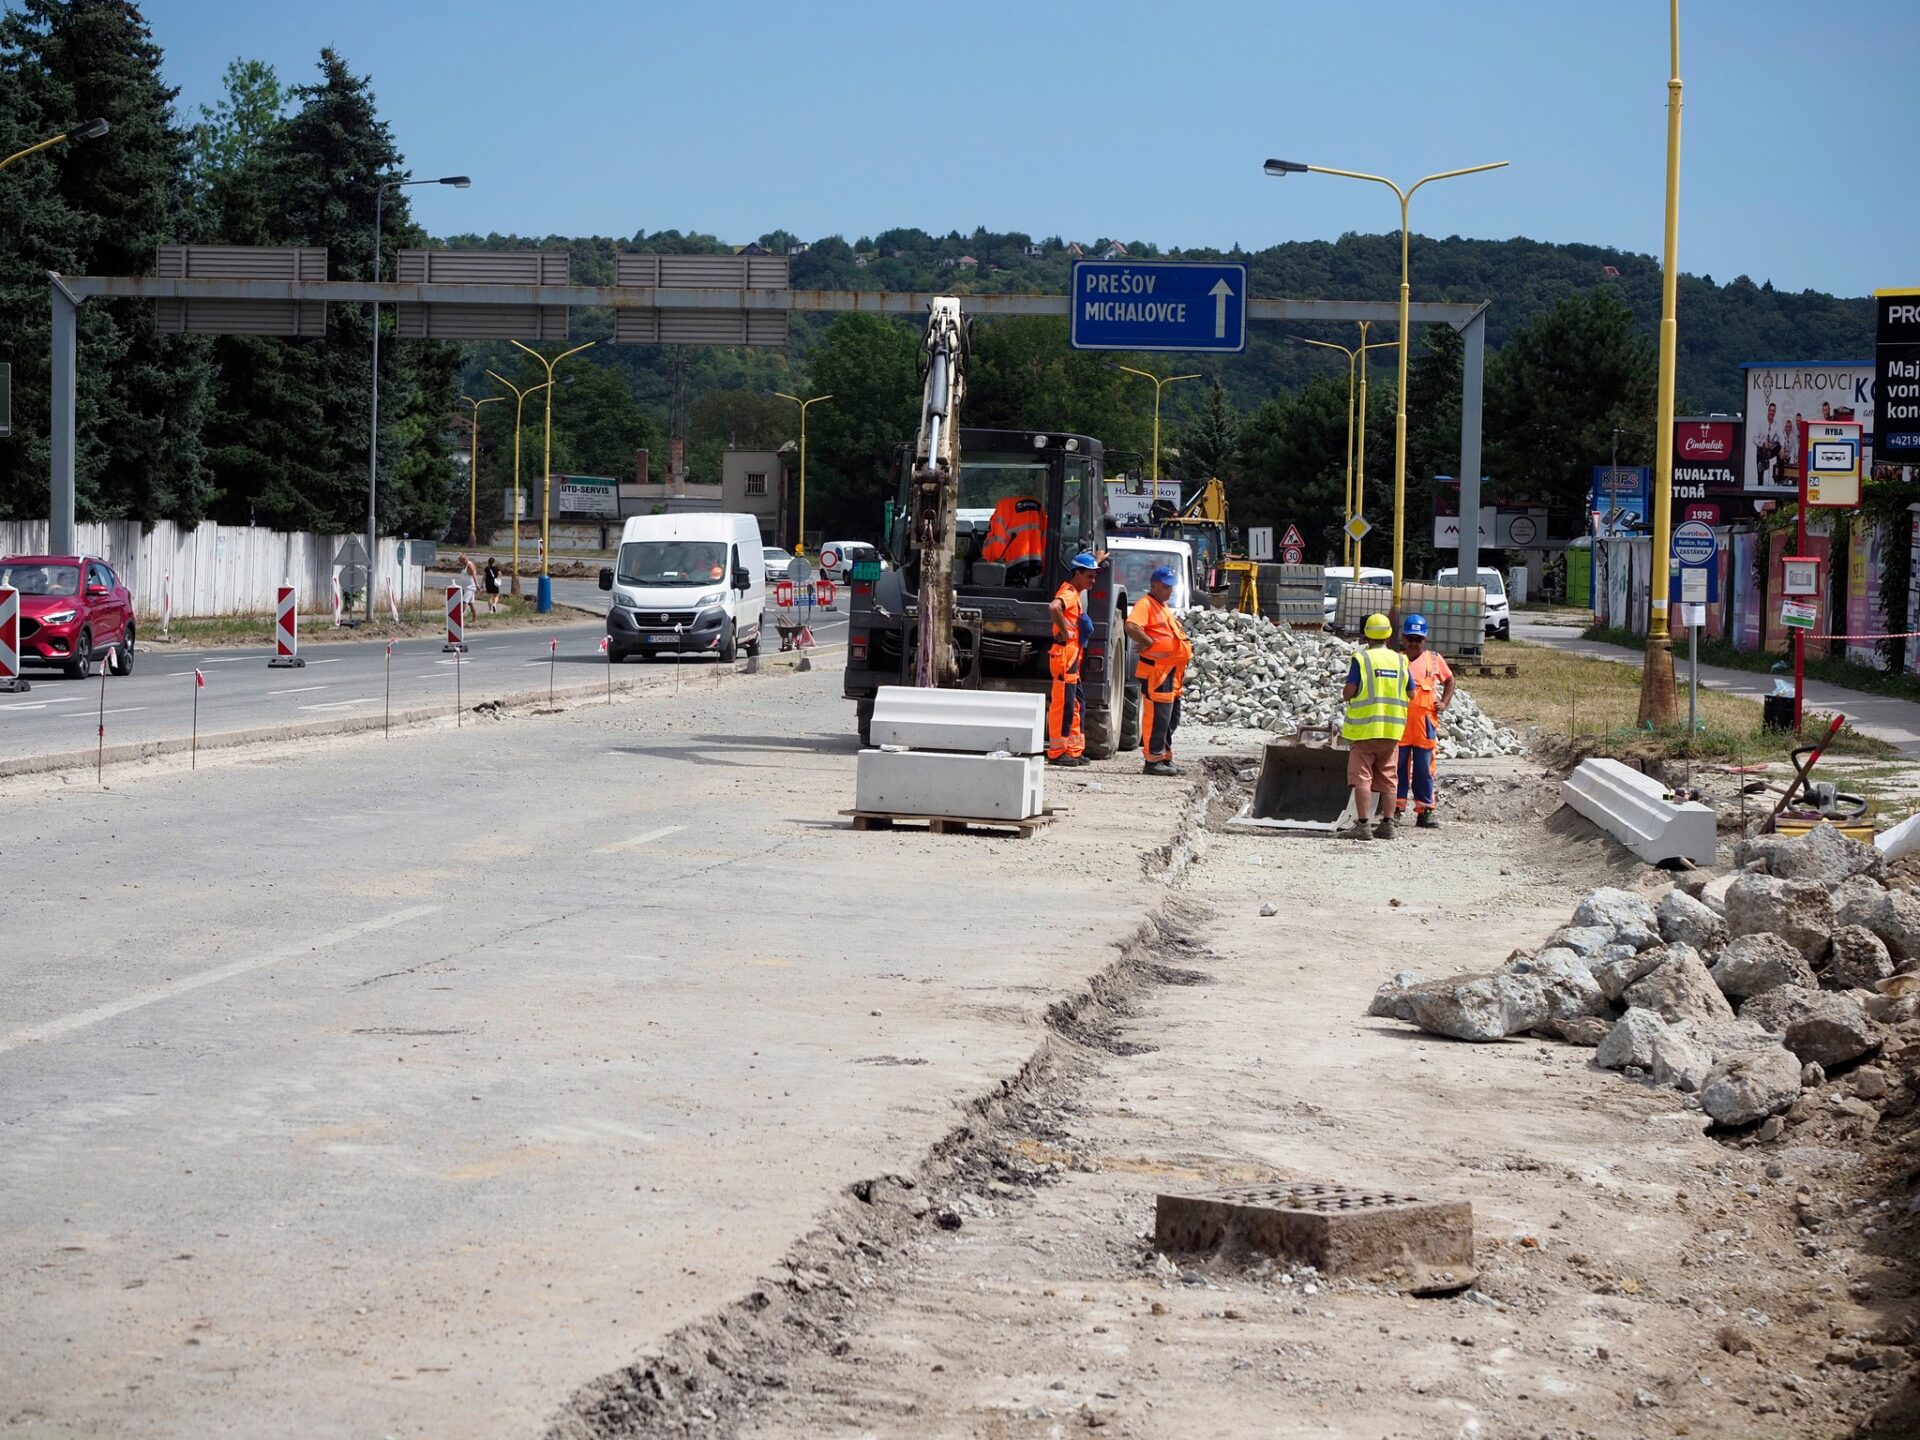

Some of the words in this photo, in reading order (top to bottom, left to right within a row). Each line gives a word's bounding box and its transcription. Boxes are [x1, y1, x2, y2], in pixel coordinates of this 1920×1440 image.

[1086, 270, 1156, 294] PREŠOV
[1085, 302, 1186, 323] MICHALOVCE
[1887, 401, 1920, 419] kon
[1825, 428, 1843, 436] RYBA
[1890, 435, 1911, 446] +421
[1674, 468, 1735, 482] KVALITA,
[1810, 478, 1819, 486] 24
[1691, 510, 1713, 519] 1992
[1288, 551, 1298, 561] 30
